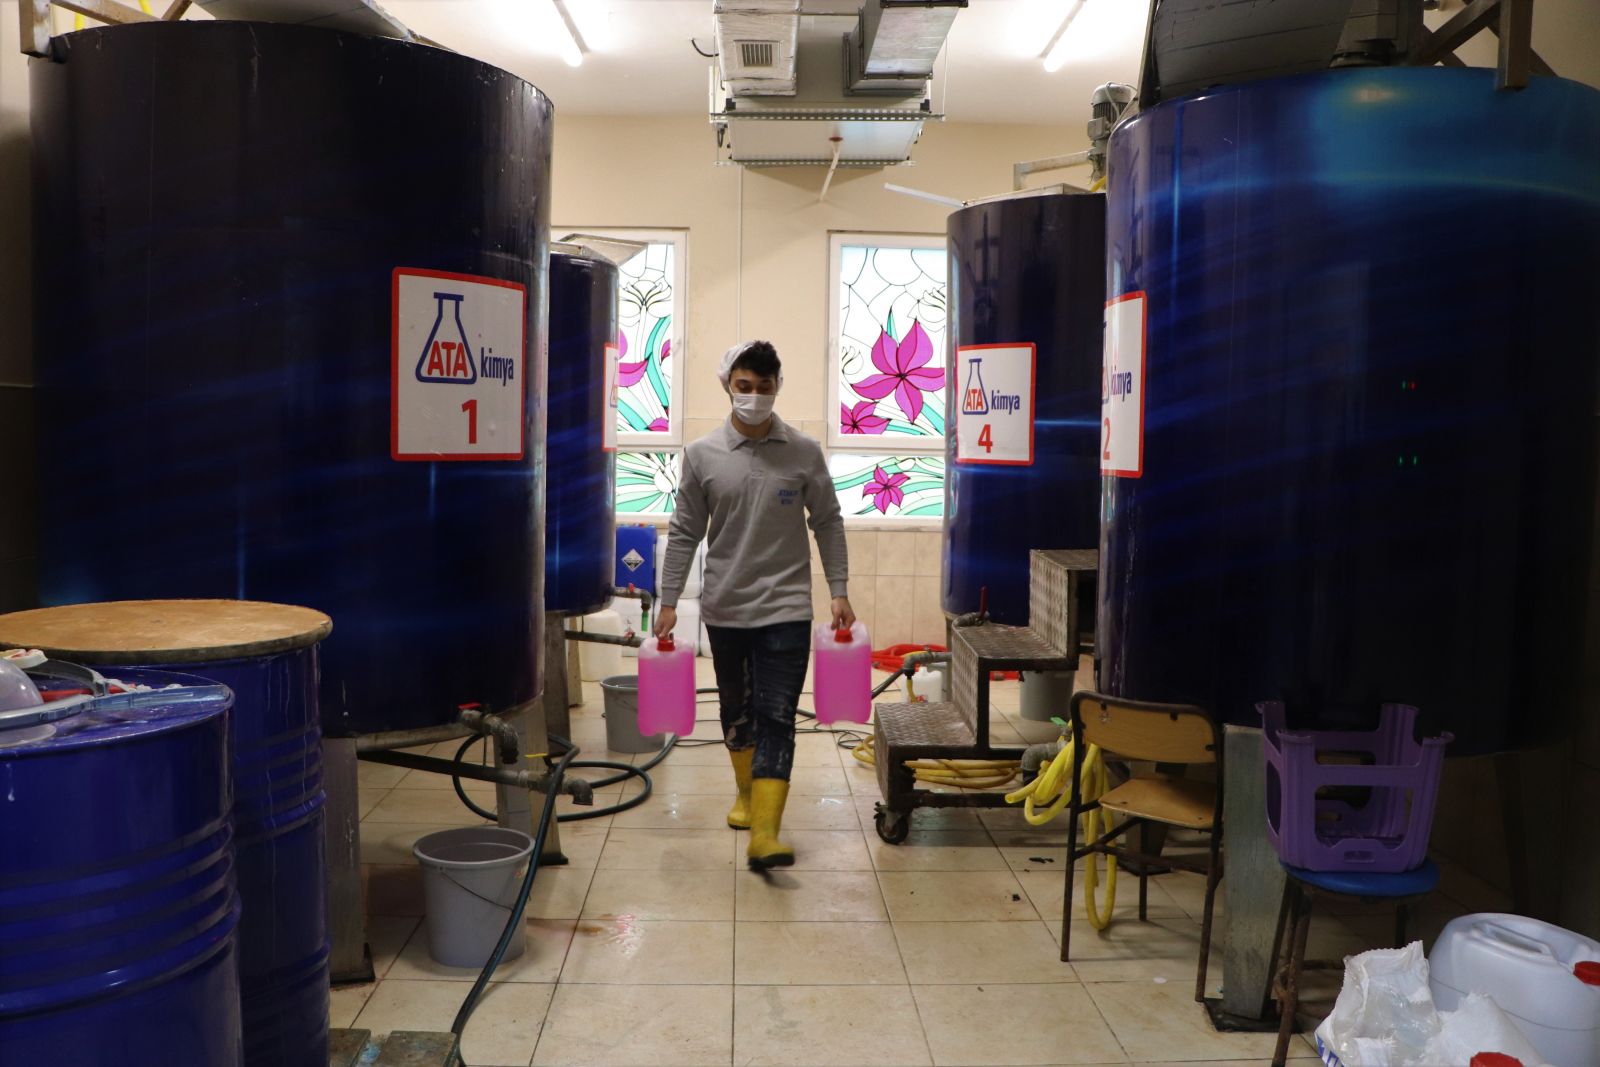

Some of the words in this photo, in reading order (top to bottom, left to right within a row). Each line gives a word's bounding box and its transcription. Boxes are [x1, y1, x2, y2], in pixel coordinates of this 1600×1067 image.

[427, 340, 468, 378] ATA
[480, 347, 514, 387] kimya
[461, 399, 477, 444] 1
[966, 389, 983, 410] ATA
[991, 390, 1020, 415] kimya
[977, 424, 993, 453] 4
[1103, 417, 1111, 460] 2
